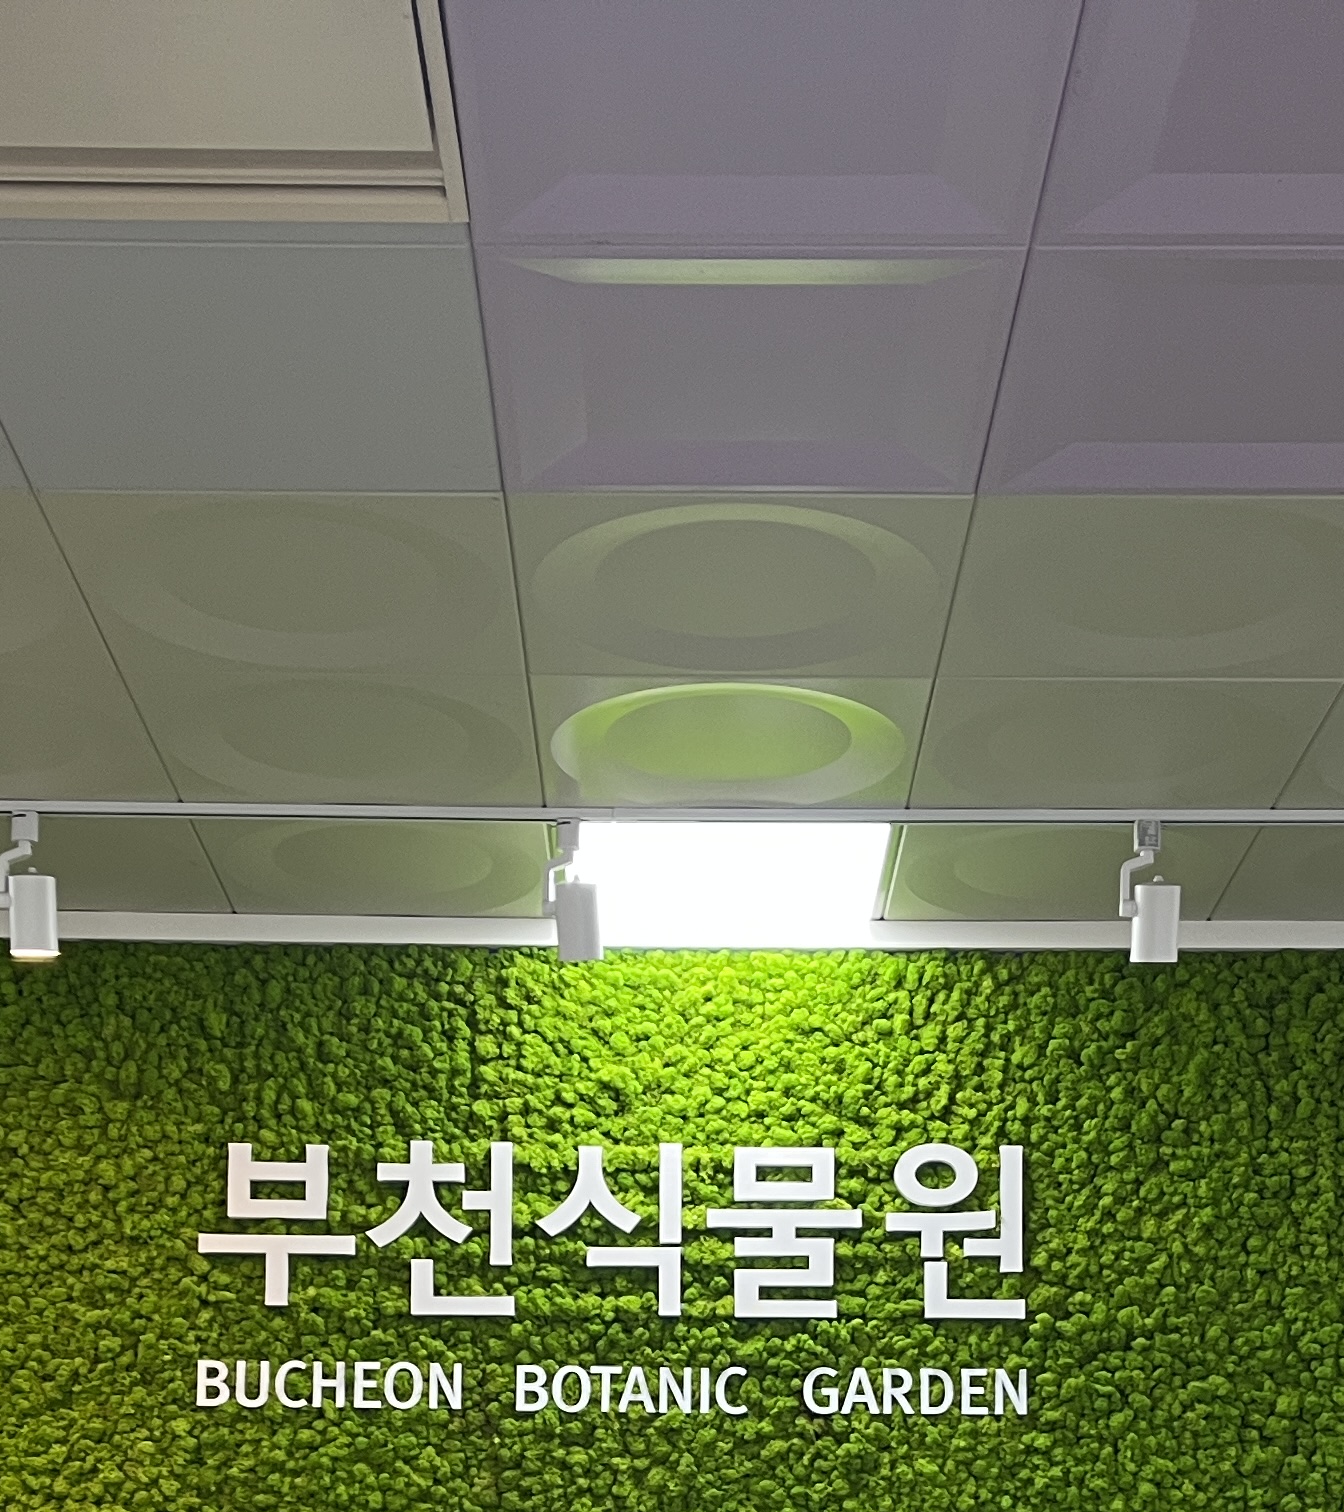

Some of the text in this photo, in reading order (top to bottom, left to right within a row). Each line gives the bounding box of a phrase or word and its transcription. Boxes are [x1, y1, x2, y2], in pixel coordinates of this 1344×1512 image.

[197, 1139, 1027, 1320] 부천식물원
[195, 1358, 1028, 1417] BUCHEON BOTANIC GARDEN
